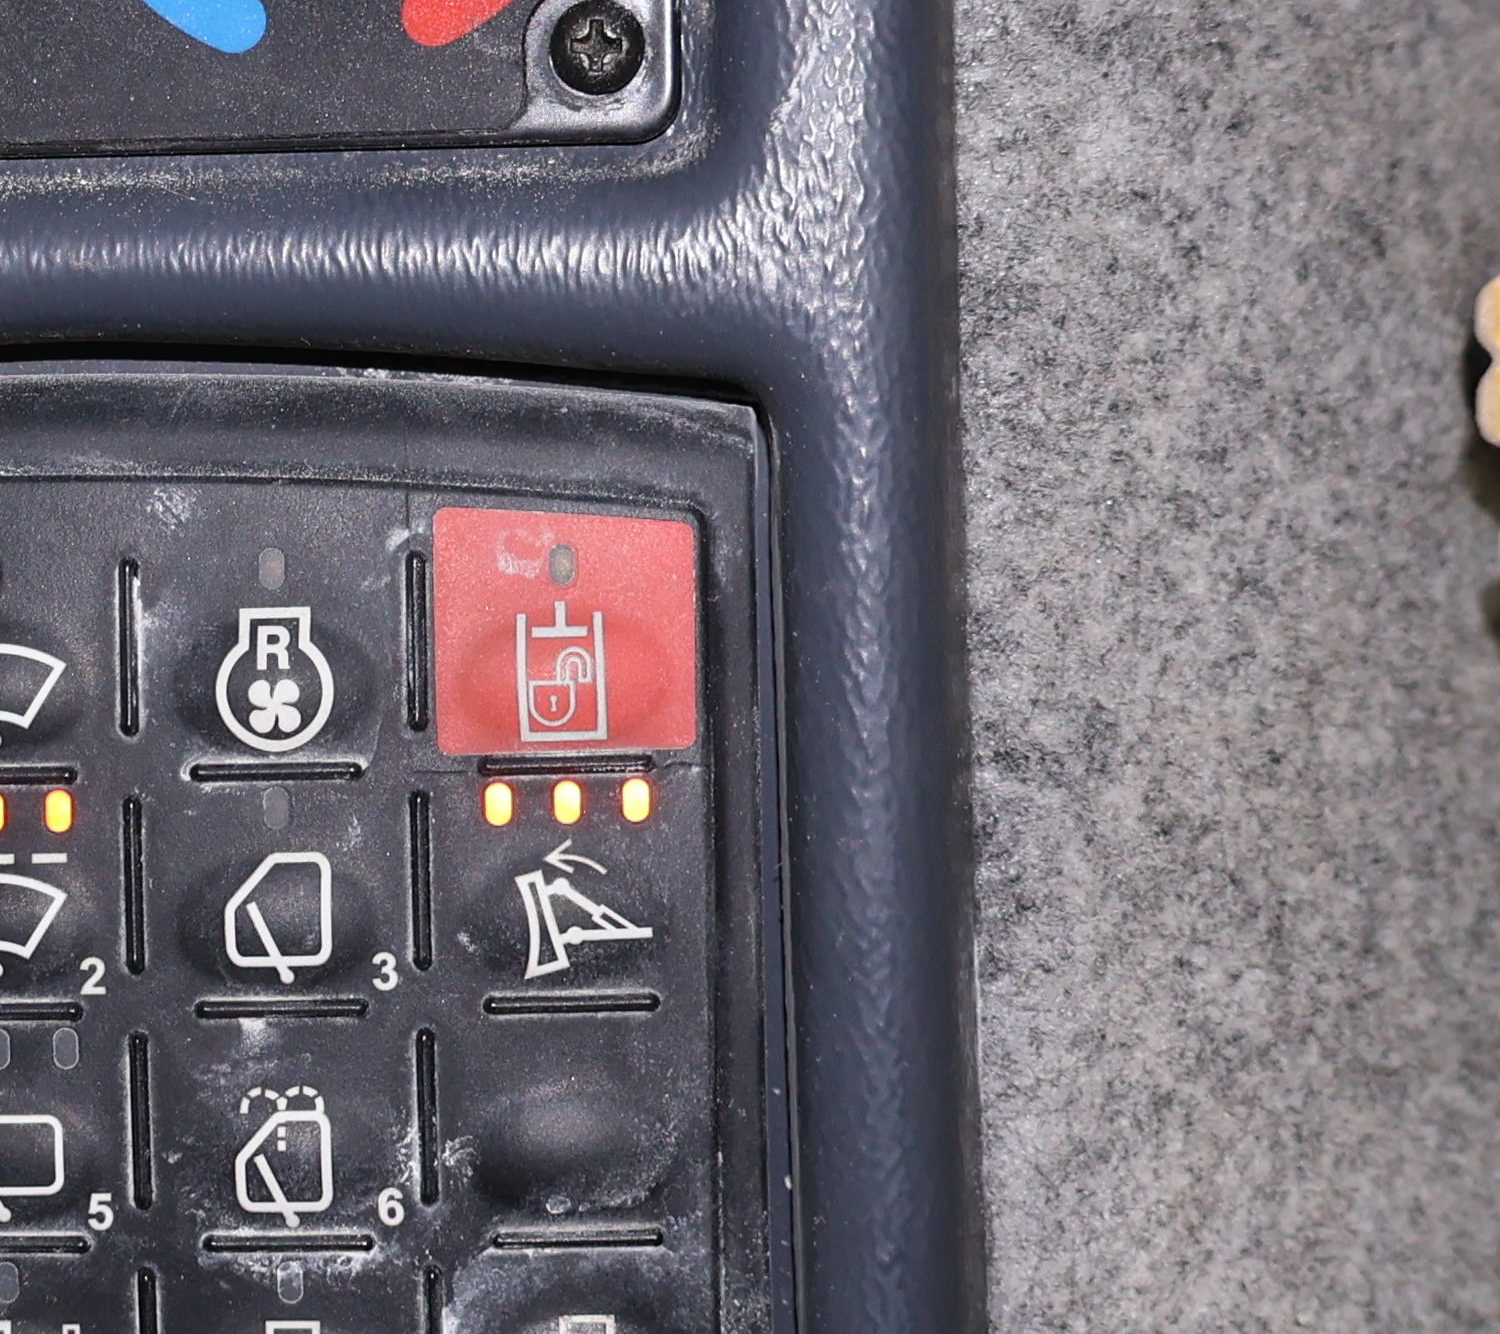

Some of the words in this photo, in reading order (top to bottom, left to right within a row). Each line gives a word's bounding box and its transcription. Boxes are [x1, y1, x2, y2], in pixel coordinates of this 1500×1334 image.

[256, 625, 291, 670] R
[79, 956, 107, 996] 2
[371, 951, 399, 991] 3
[87, 1192, 114, 1231] 5
[377, 1186, 405, 1227] 6
